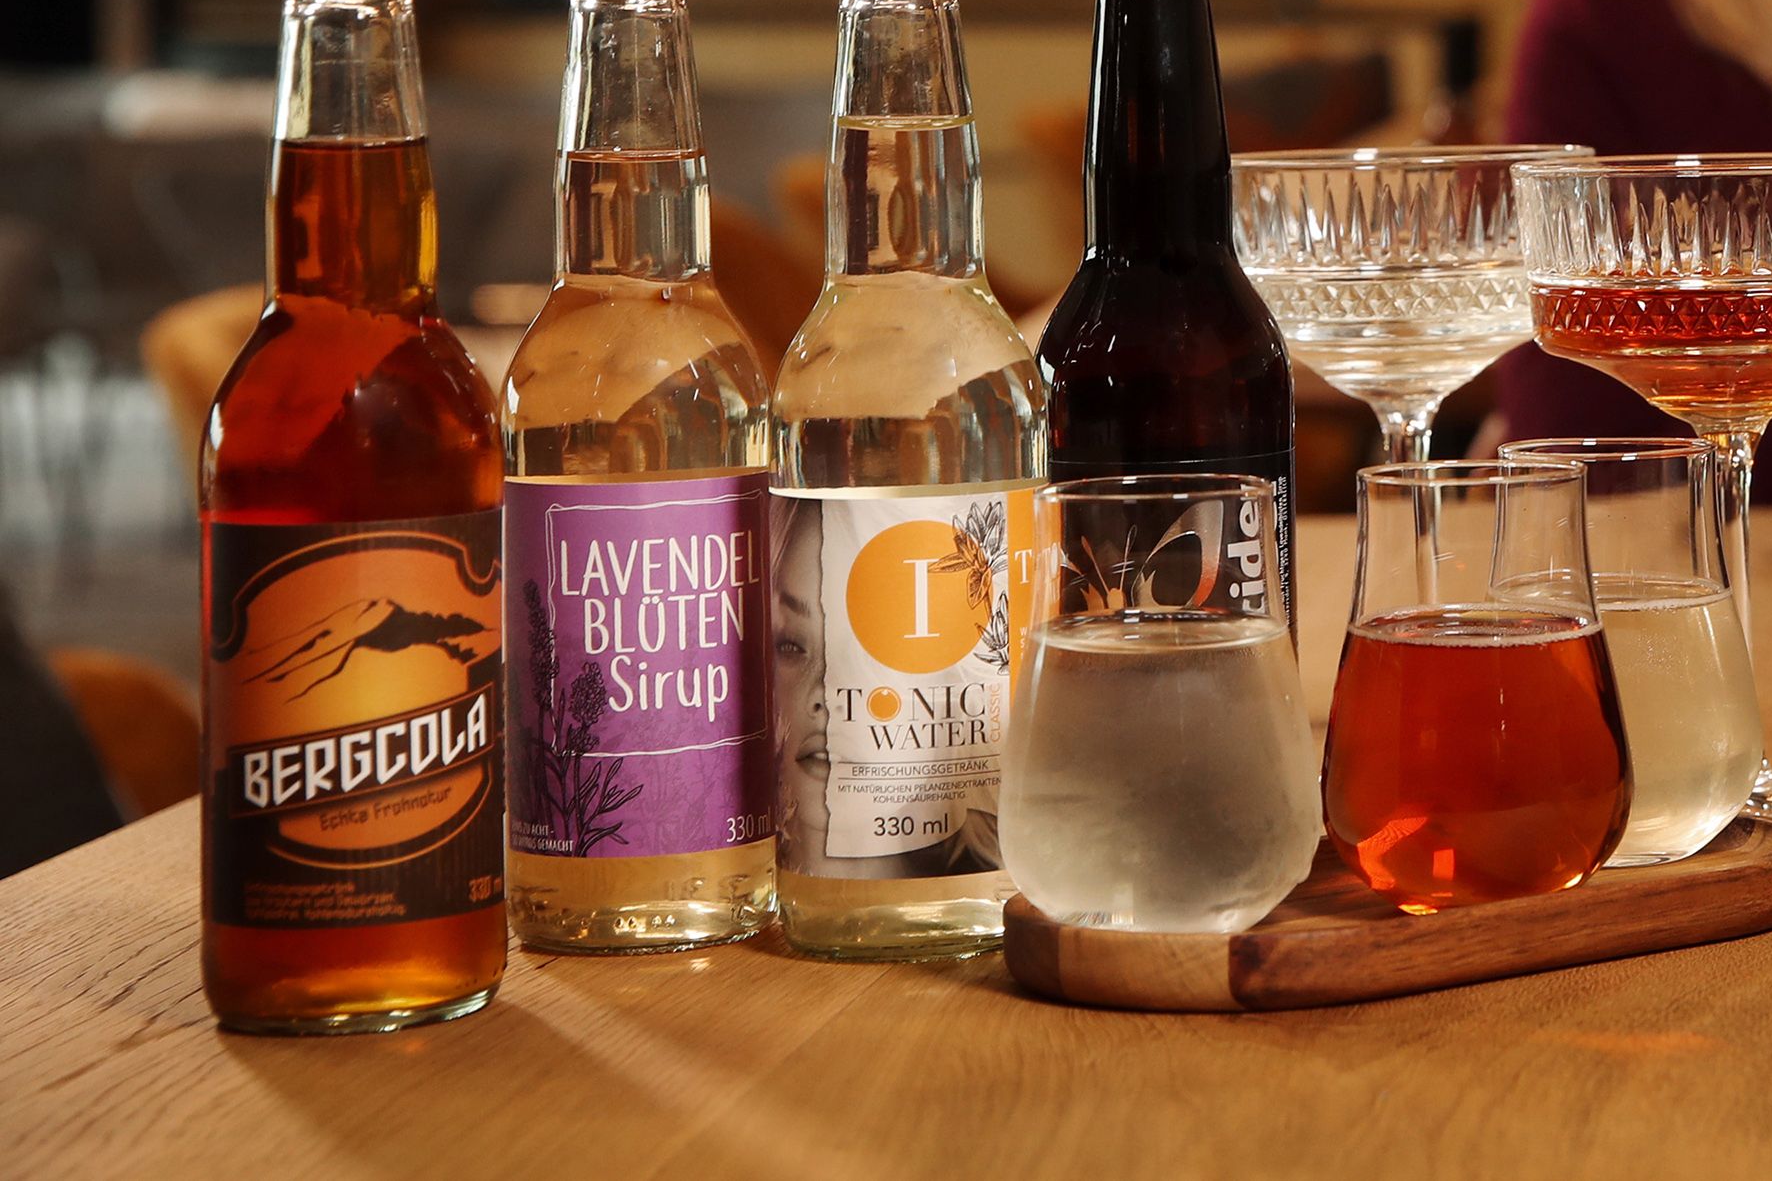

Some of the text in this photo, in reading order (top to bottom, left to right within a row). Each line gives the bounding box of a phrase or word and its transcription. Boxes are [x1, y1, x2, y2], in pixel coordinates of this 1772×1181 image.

[559, 529, 760, 597] LAVENDEL
[584, 587, 744, 655] BLÜTEN
[608, 655, 729, 722] Sirup
[989, 683, 1001, 743] CLASSIC
[244, 693, 487, 808] BERGCOLA
[868, 721, 988, 751] WATER
[838, 784, 851, 794] MIT
[726, 814, 754, 843] 330
[873, 813, 949, 837] 330 ml
